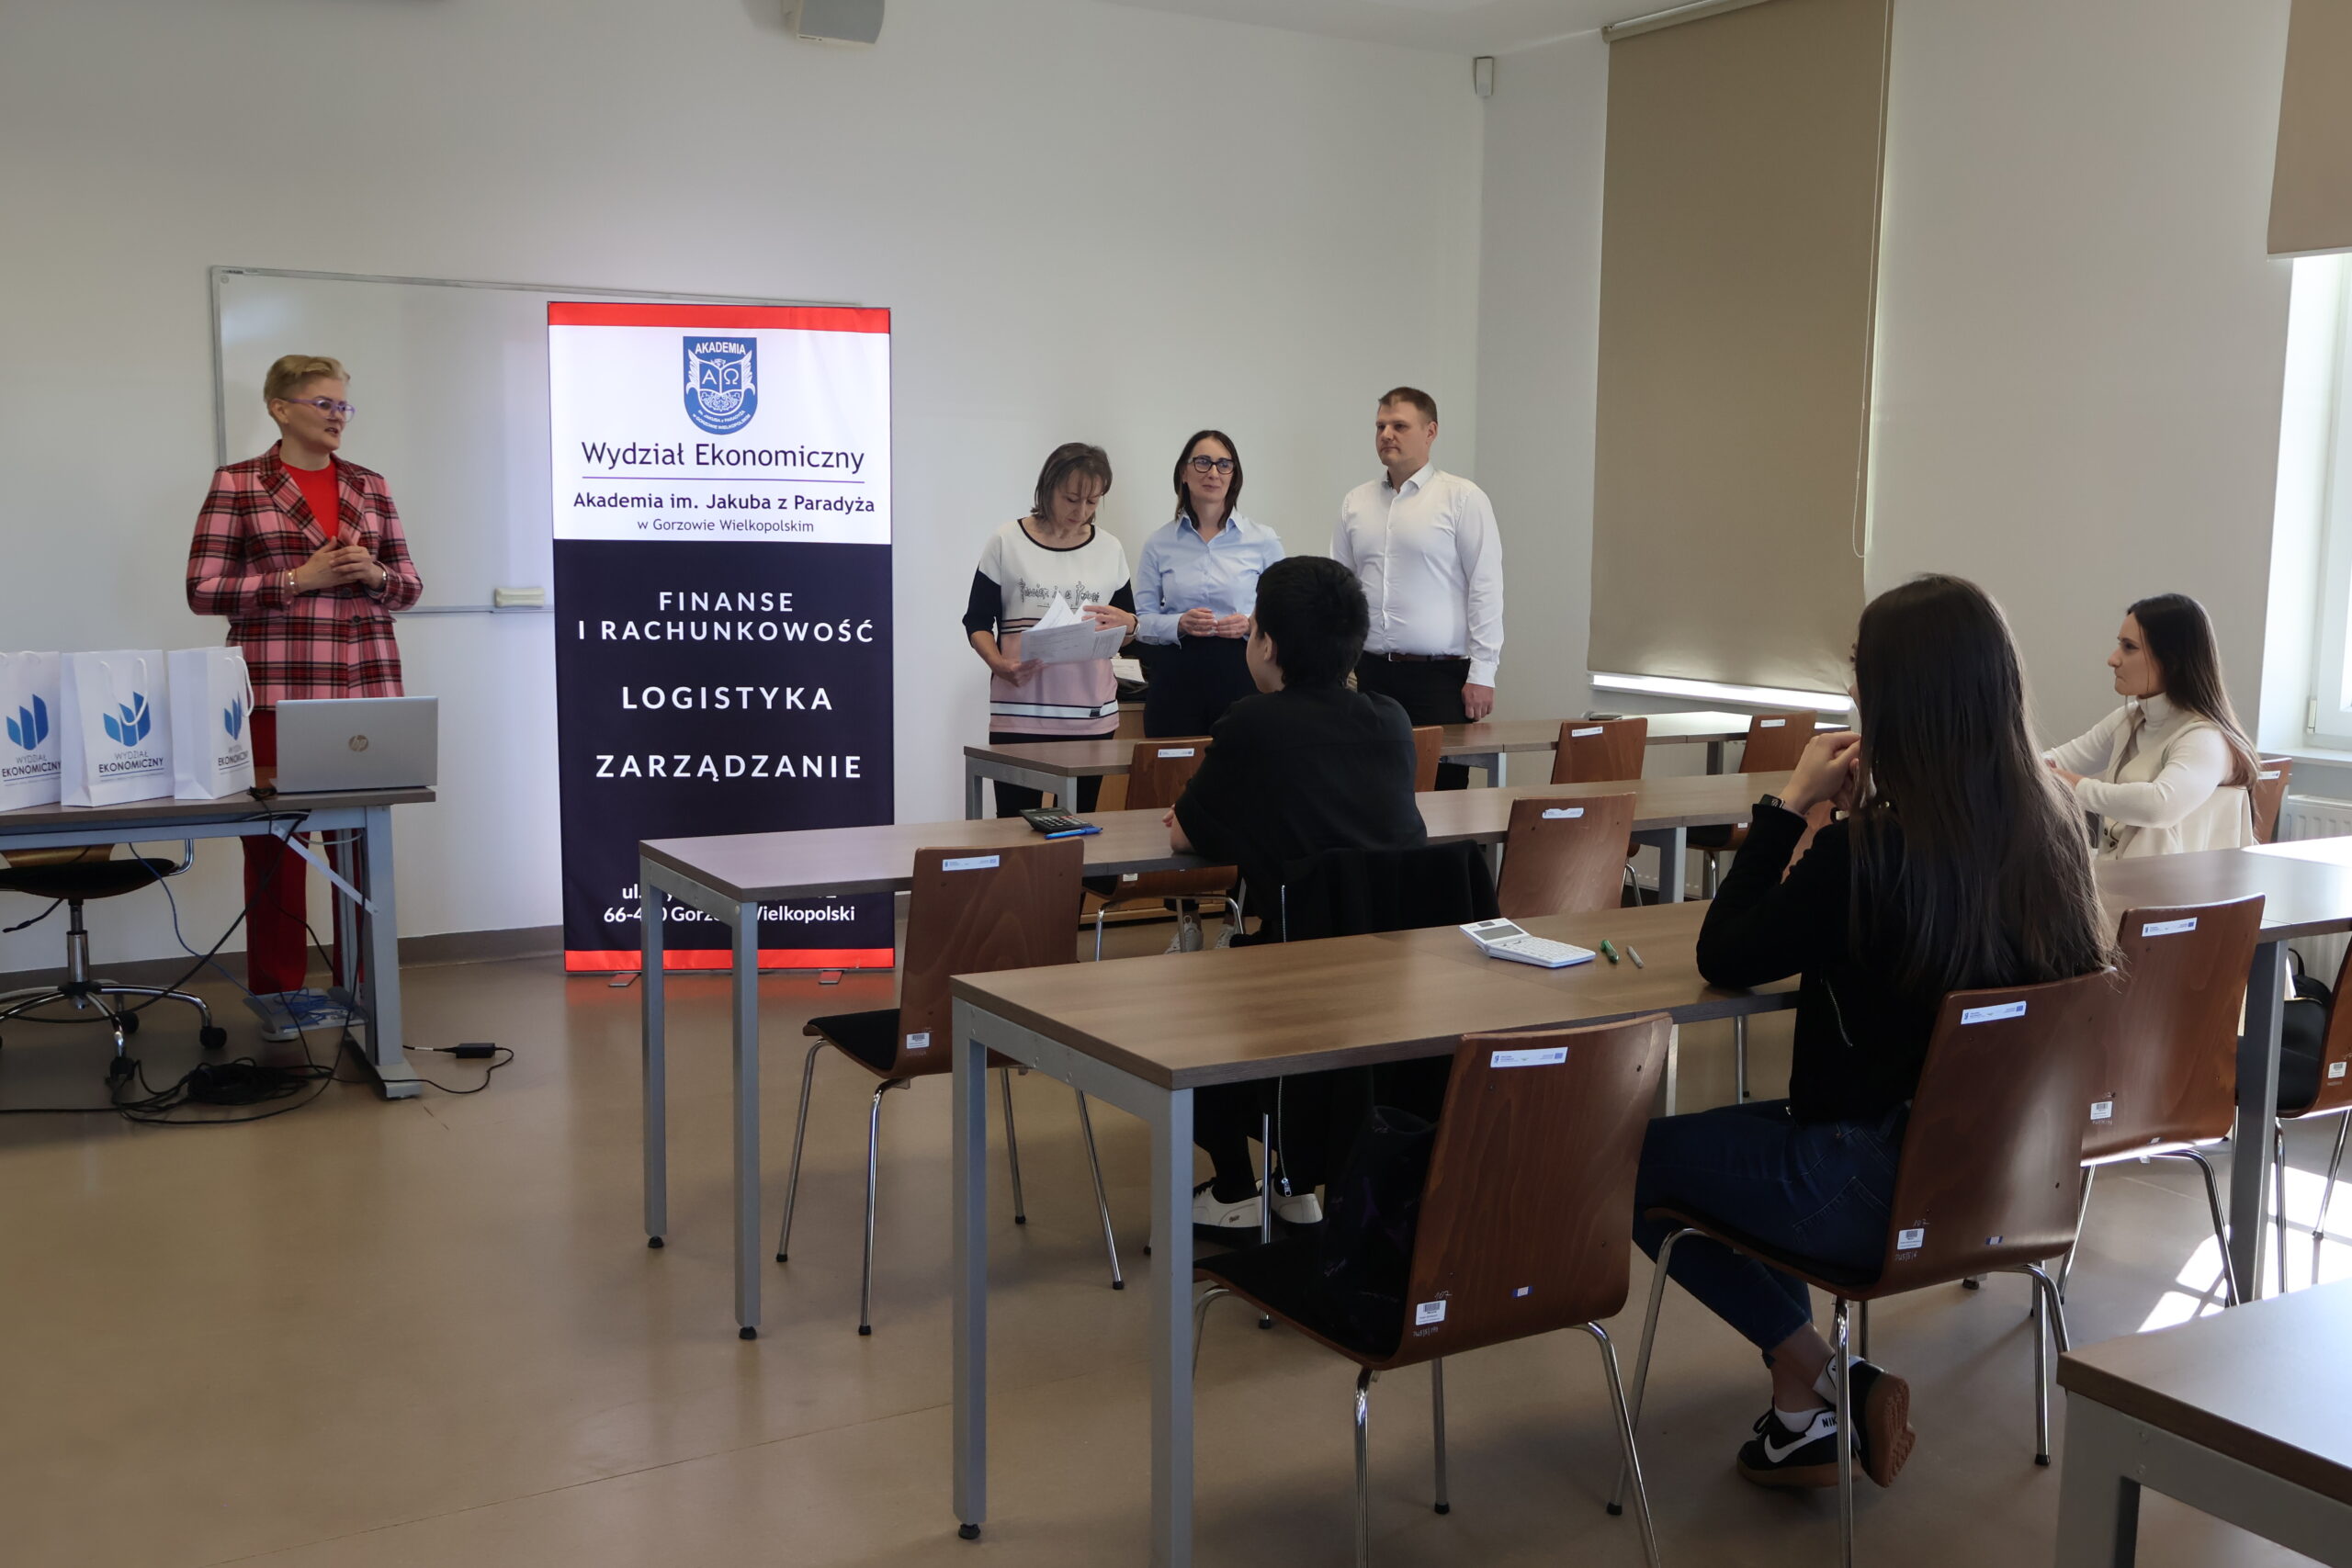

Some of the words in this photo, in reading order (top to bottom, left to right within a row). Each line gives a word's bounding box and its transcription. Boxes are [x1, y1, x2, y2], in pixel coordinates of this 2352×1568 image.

[695, 342, 746, 355] AKADEMIA
[582, 442, 684, 469] Wydział
[695, 444, 865, 474] Ekonomiczny
[573, 492, 663, 509] Akademia
[670, 493, 698, 509] im.
[707, 494, 771, 510] Jakuba
[777, 498, 787, 510] z
[794, 495, 875, 514] Paradyża
[637, 521, 648, 530] w
[653, 519, 715, 531] Gorzowie
[719, 520, 814, 534] Wielkopolskim
[660, 592, 792, 612] FINANSE
[579, 621, 584, 639] I
[602, 619, 874, 643] RACHUNKOWOŚĆ
[622, 687, 832, 710] LOGISTYKA
[98, 758, 164, 773] EKONOMICZNY
[596, 755, 861, 782] ZARZĄDZANIE
[1822, 1416, 1838, 1428] NIK
